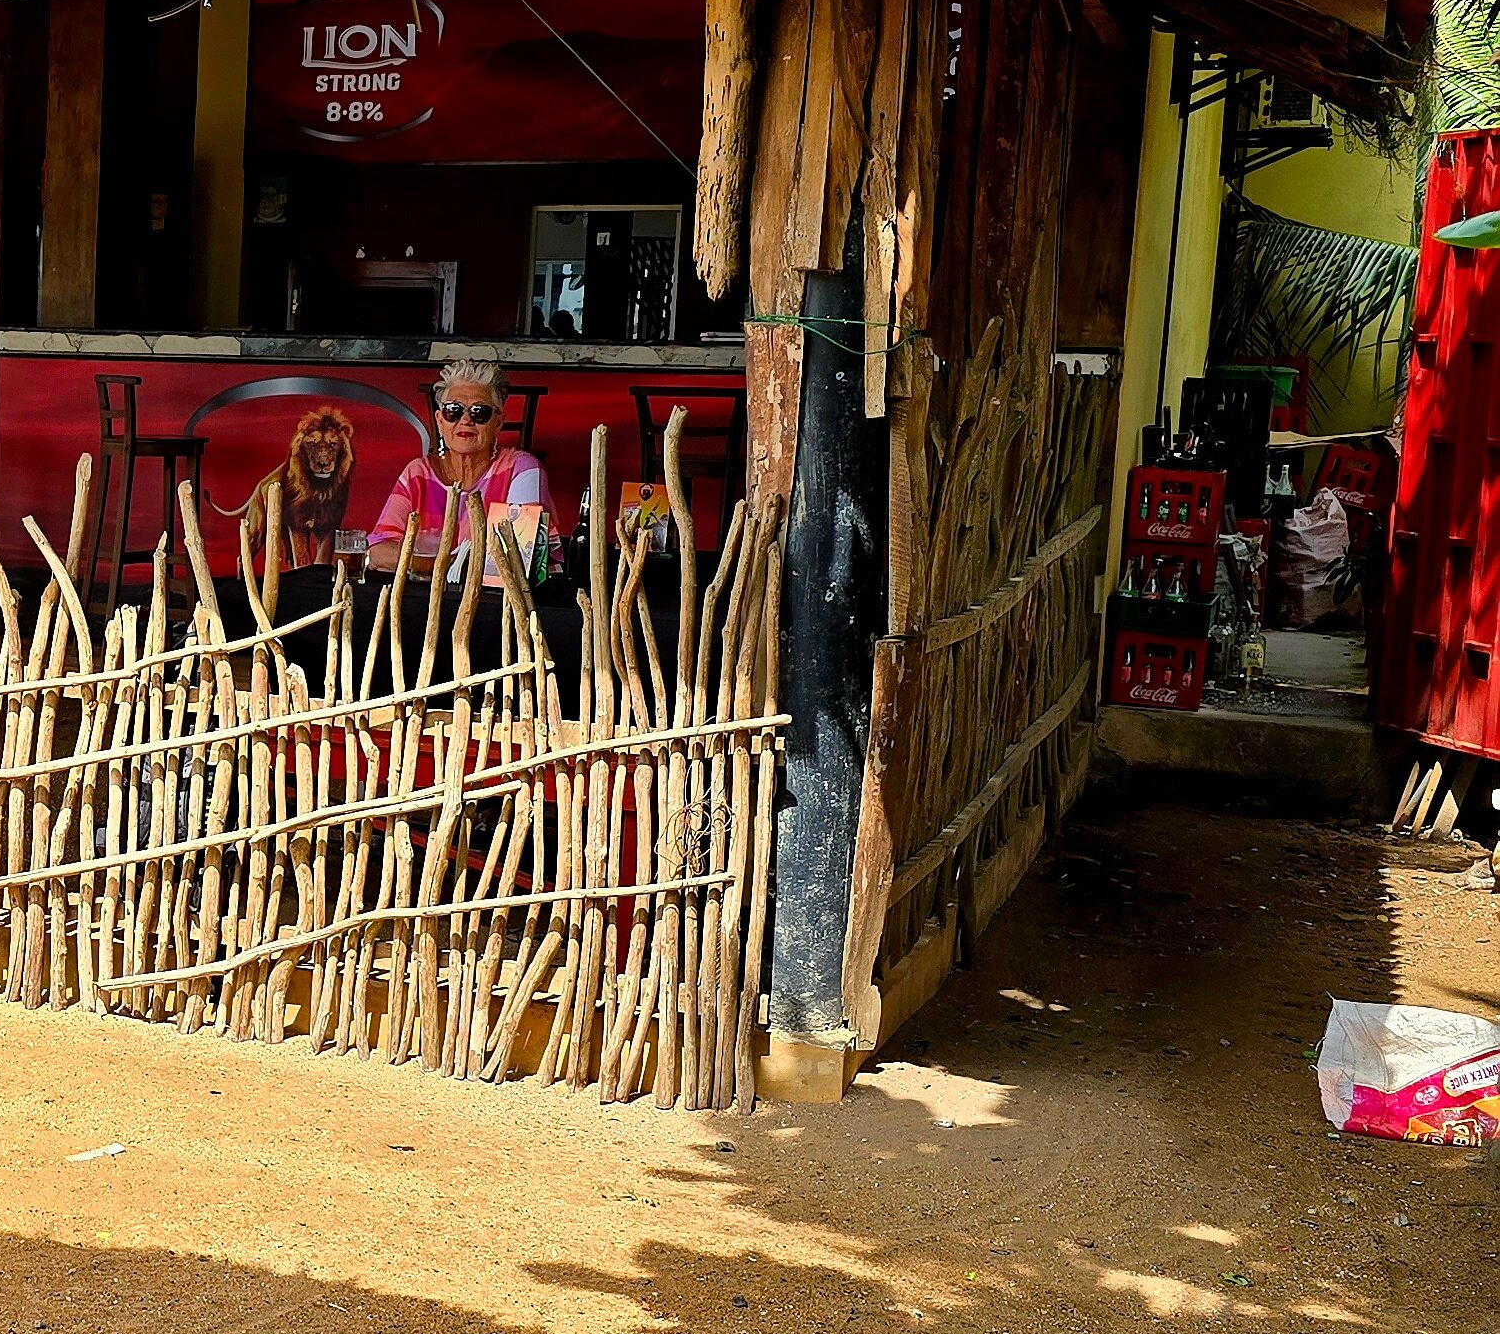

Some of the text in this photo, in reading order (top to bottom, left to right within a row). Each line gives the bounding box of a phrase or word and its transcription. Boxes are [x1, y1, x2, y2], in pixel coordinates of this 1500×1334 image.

[301, 23, 417, 70] LION
[315, 72, 401, 93] STRONG
[1449, 1064, 1499, 1090] ORTEX RICE
